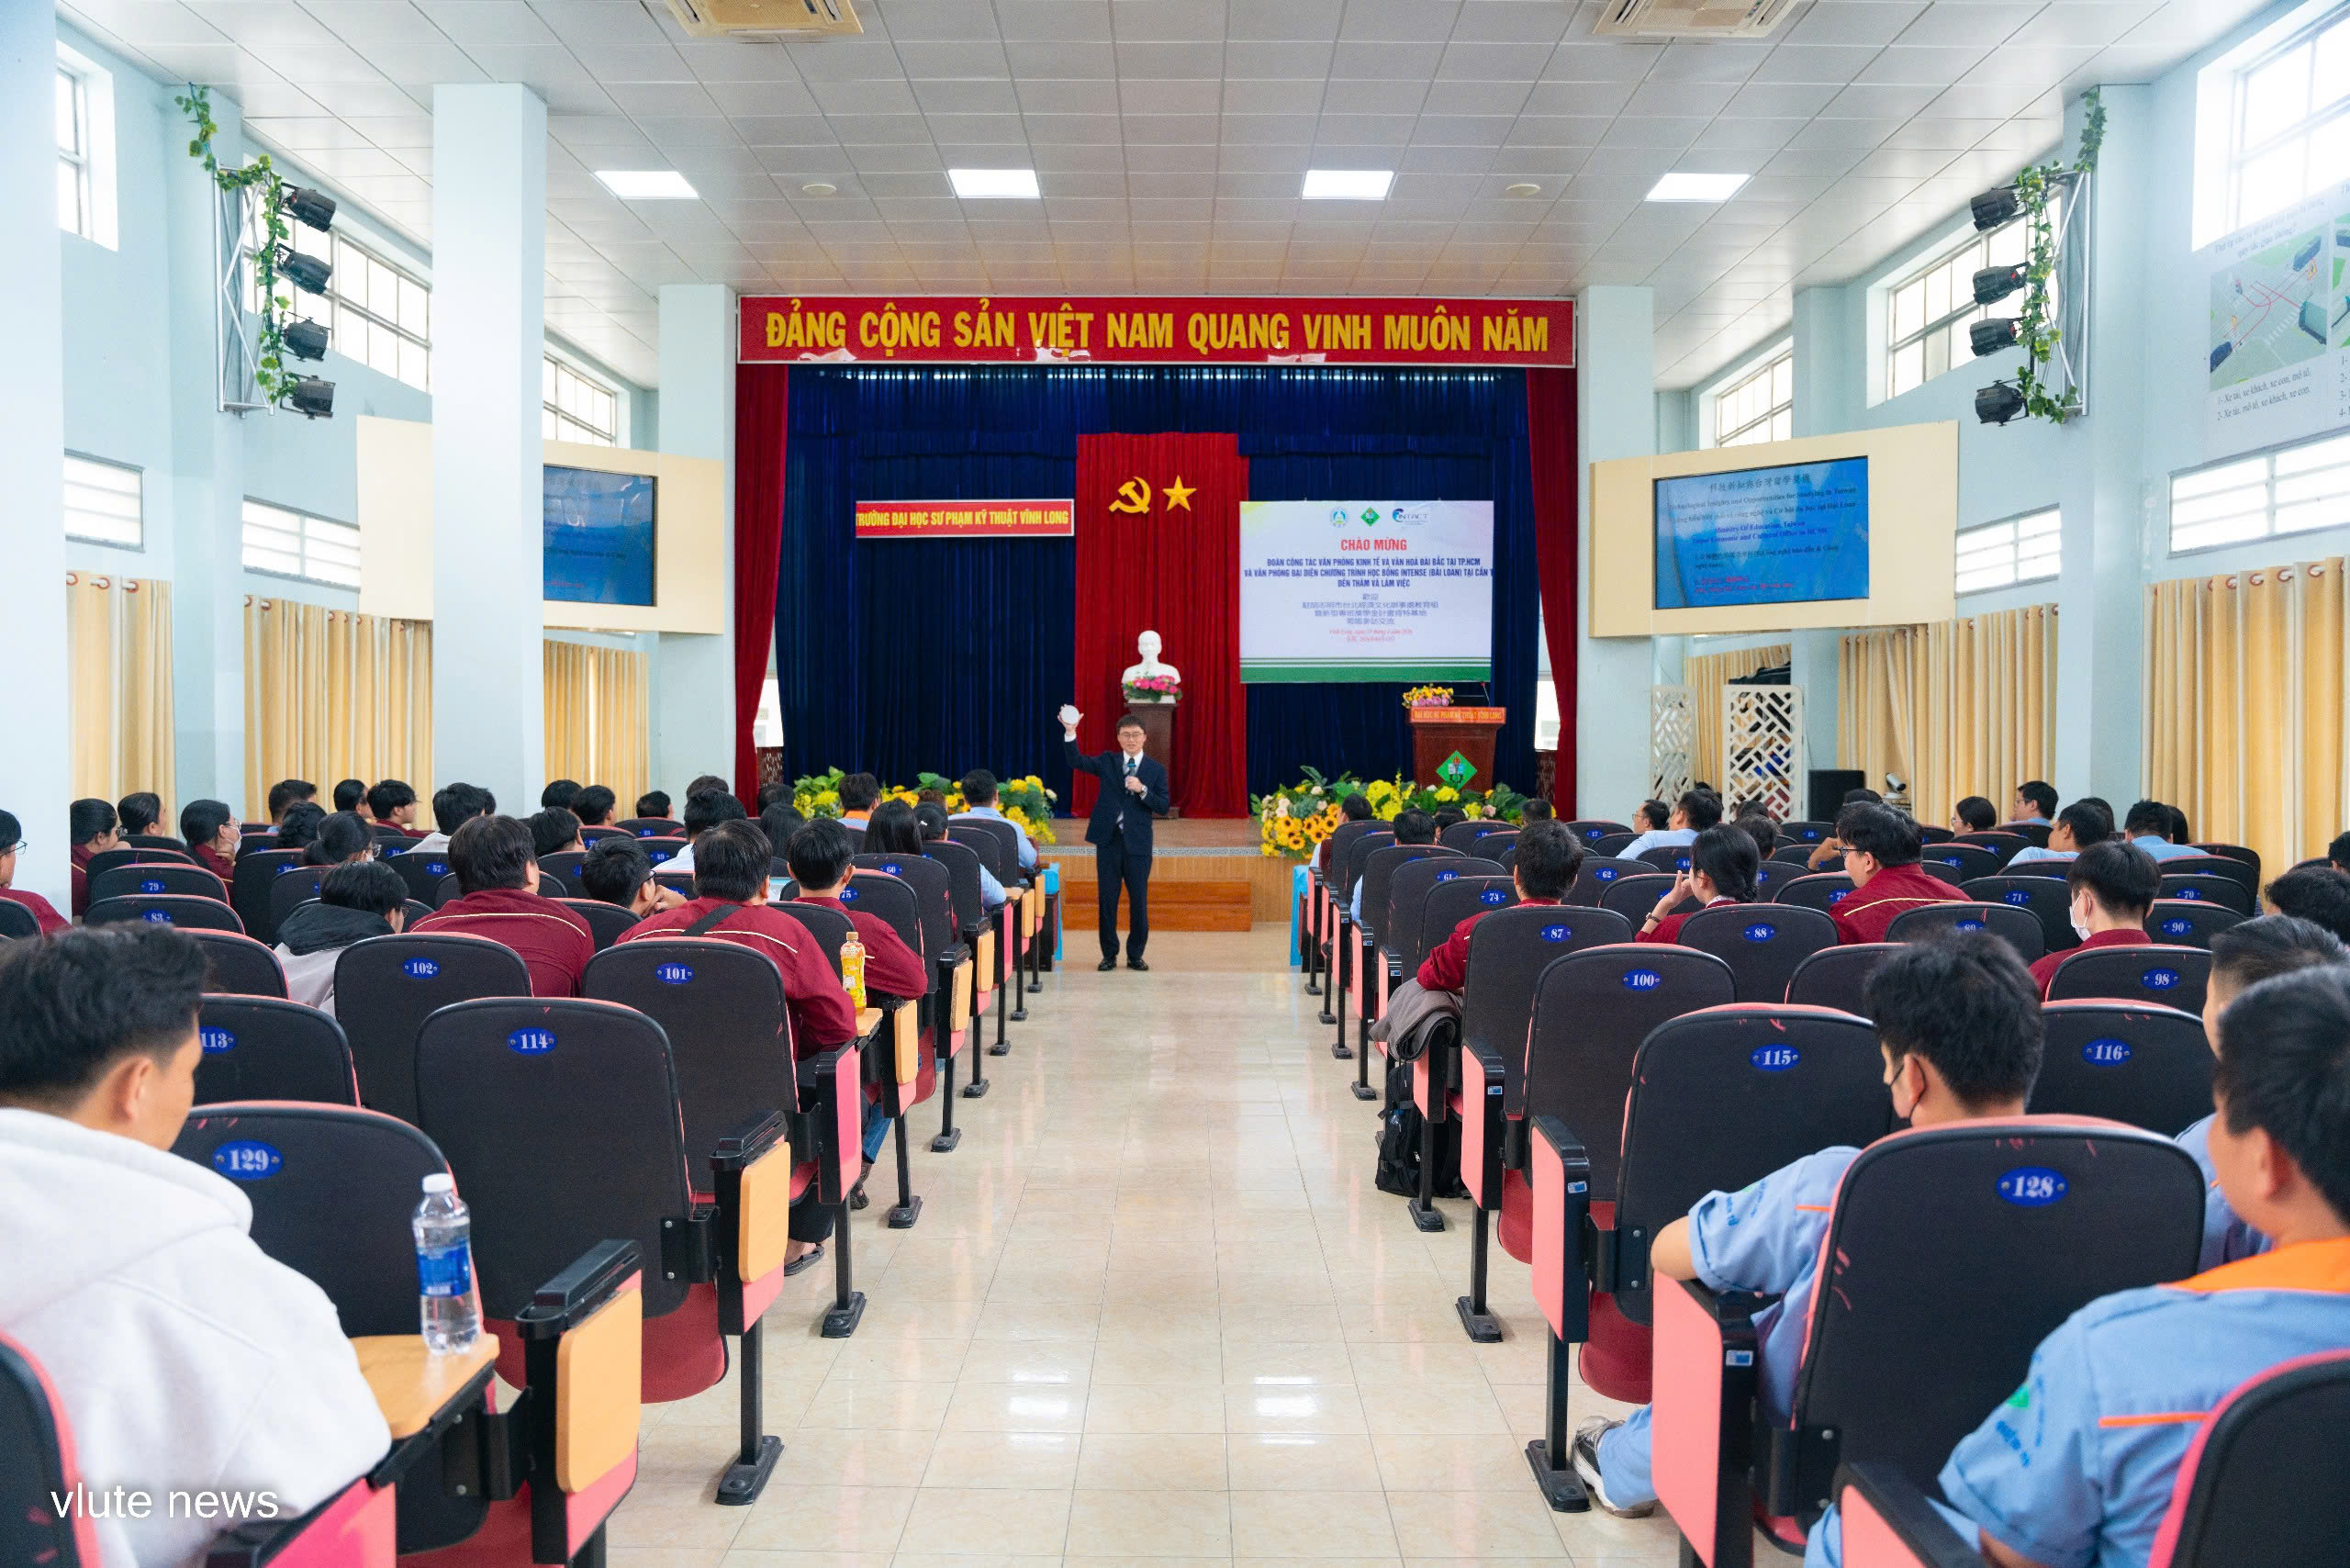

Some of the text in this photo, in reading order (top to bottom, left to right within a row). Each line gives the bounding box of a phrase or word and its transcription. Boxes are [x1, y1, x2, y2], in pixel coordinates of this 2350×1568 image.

[766, 298, 1548, 357] ĐẢNG CỘNG SẢN VIỆT NAM QUANG VINH MUÔN NĂM
[892, 512, 907, 529] ĐẠI
[910, 512, 928, 528] HỌC
[931, 510, 945, 525] SƯ
[946, 511, 973, 528] PHẠM
[989, 509, 1019, 527] THUẬT
[1020, 509, 1042, 525] VĨNH
[1044, 510, 1069, 525] LONG
[1340, 537, 1407, 551] CHÀO MỪNG
[1286, 556, 1304, 566] CÔNG
[1356, 558, 1371, 566] KINH
[1401, 568, 1427, 577] INTENSE
[1443, 873, 1453, 881] 61
[149, 882, 160, 891] 79
[841, 890, 852, 899] 75
[1489, 892, 1499, 902] 74
[2012, 893, 2022, 902] 71
[2185, 890, 2195, 900] 70
[151, 913, 163, 923] 83
[1550, 928, 1563, 939] 87
[1754, 927, 1767, 938] 88
[2171, 922, 2184, 932] 90
[412, 962, 434, 975] 102
[665, 967, 688, 980] 101
[1631, 974, 1654, 987] 100
[2154, 973, 2170, 986] 98
[200, 1033, 228, 1048] 113
[520, 1034, 549, 1049] 114
[1762, 1049, 1792, 1066] 115
[2094, 1044, 2123, 1061] 116
[229, 1148, 270, 1171] 129
[2012, 1175, 2054, 1198] 128
